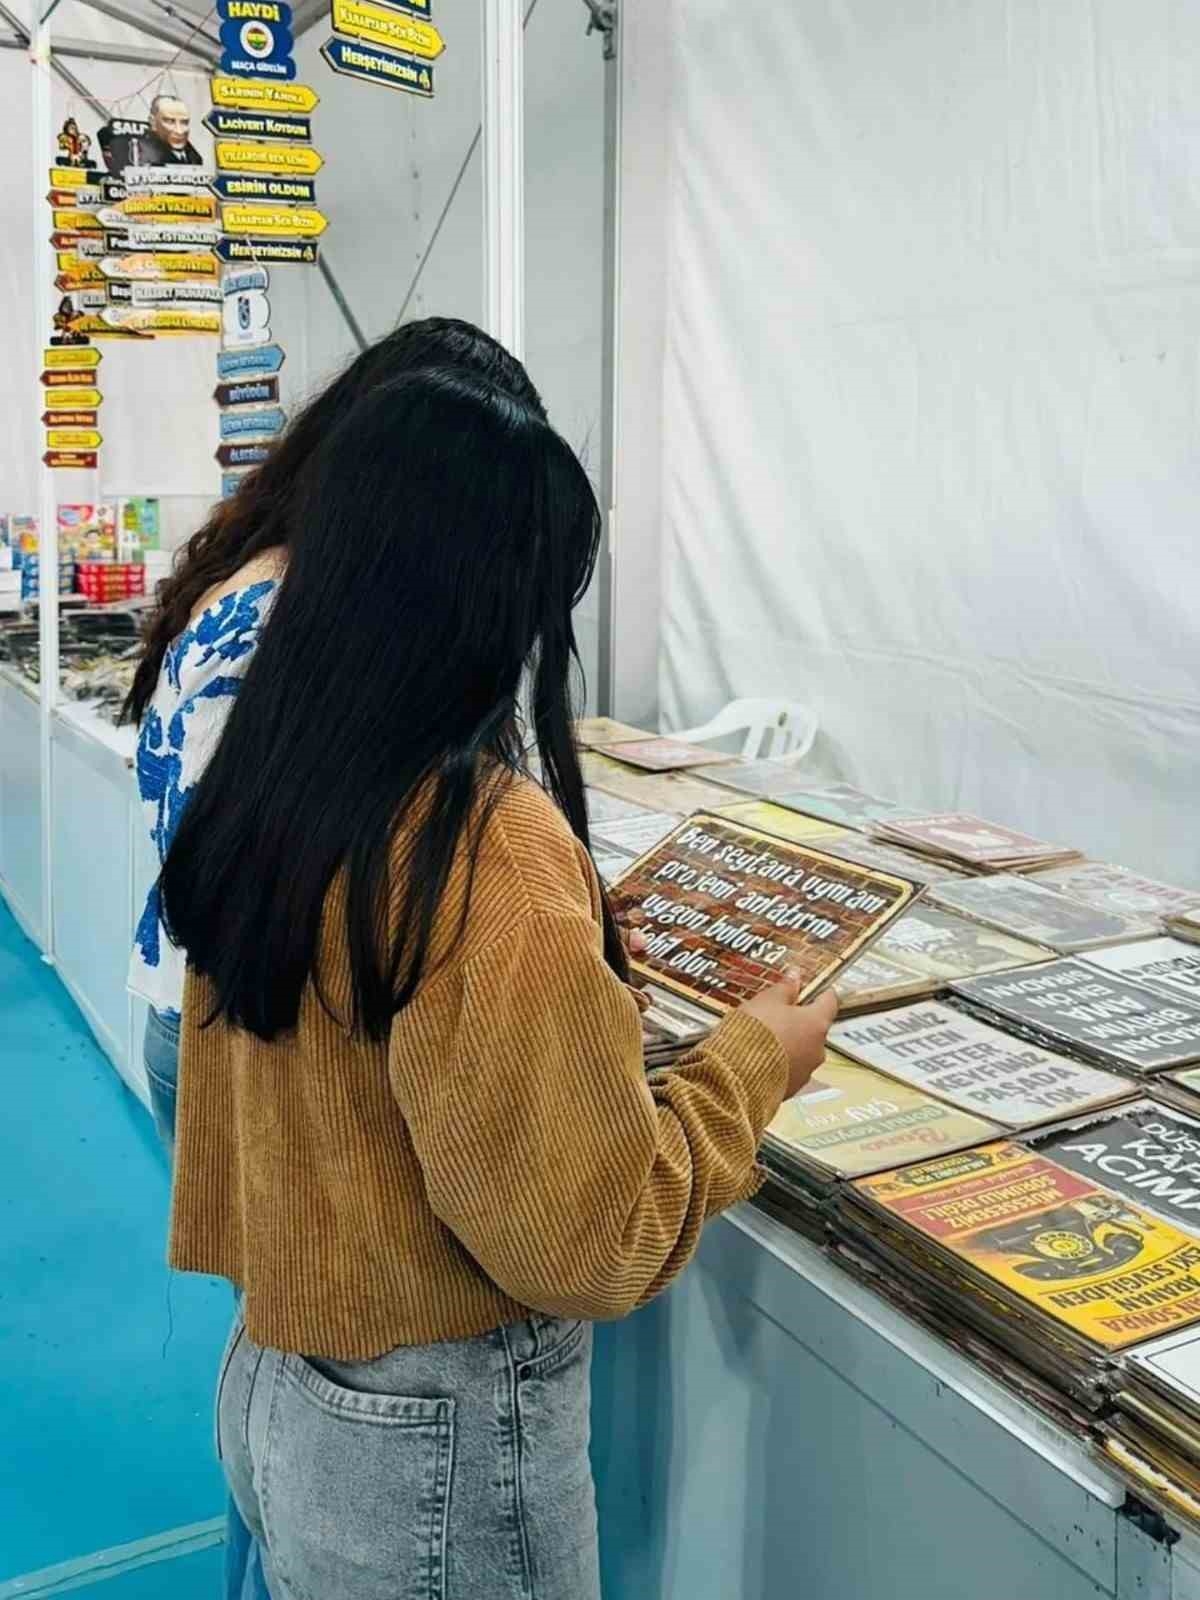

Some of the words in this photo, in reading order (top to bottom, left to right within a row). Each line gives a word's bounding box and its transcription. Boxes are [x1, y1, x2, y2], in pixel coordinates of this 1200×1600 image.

[228, 1, 280, 21] HAYDİ
[226, 179, 267, 193] ESİRİN
[268, 183, 310, 197] OLDUM
[653, 860, 744, 899] projemi
[712, 844, 805, 887] şeytana
[801, 875, 887, 914] uymam
[641, 893, 710, 930] uygun
[702, 914, 787, 964] bulursa
[981, 970, 1094, 999] SIRADAN
[1067, 983, 1115, 999] EN
[1055, 995, 1147, 1022] AMA
[912, 1041, 1003, 1073] BETER
[927, 1051, 1048, 1091] KEYFİMİZ
[967, 1067, 1080, 1103] PASADA
[1025, 1086, 1091, 1108] YOK
[1141, 1122, 1200, 1157] DÜŞ
[976, 1174, 1056, 1203] SORUMLU
[1061, 1143, 1200, 1210] ACIM
[1048, 1263, 1176, 1309] SEVGİLİDEN
[1115, 1275, 1200, 1311] ARANAN
[1100, 1306, 1183, 1333] SONRA
